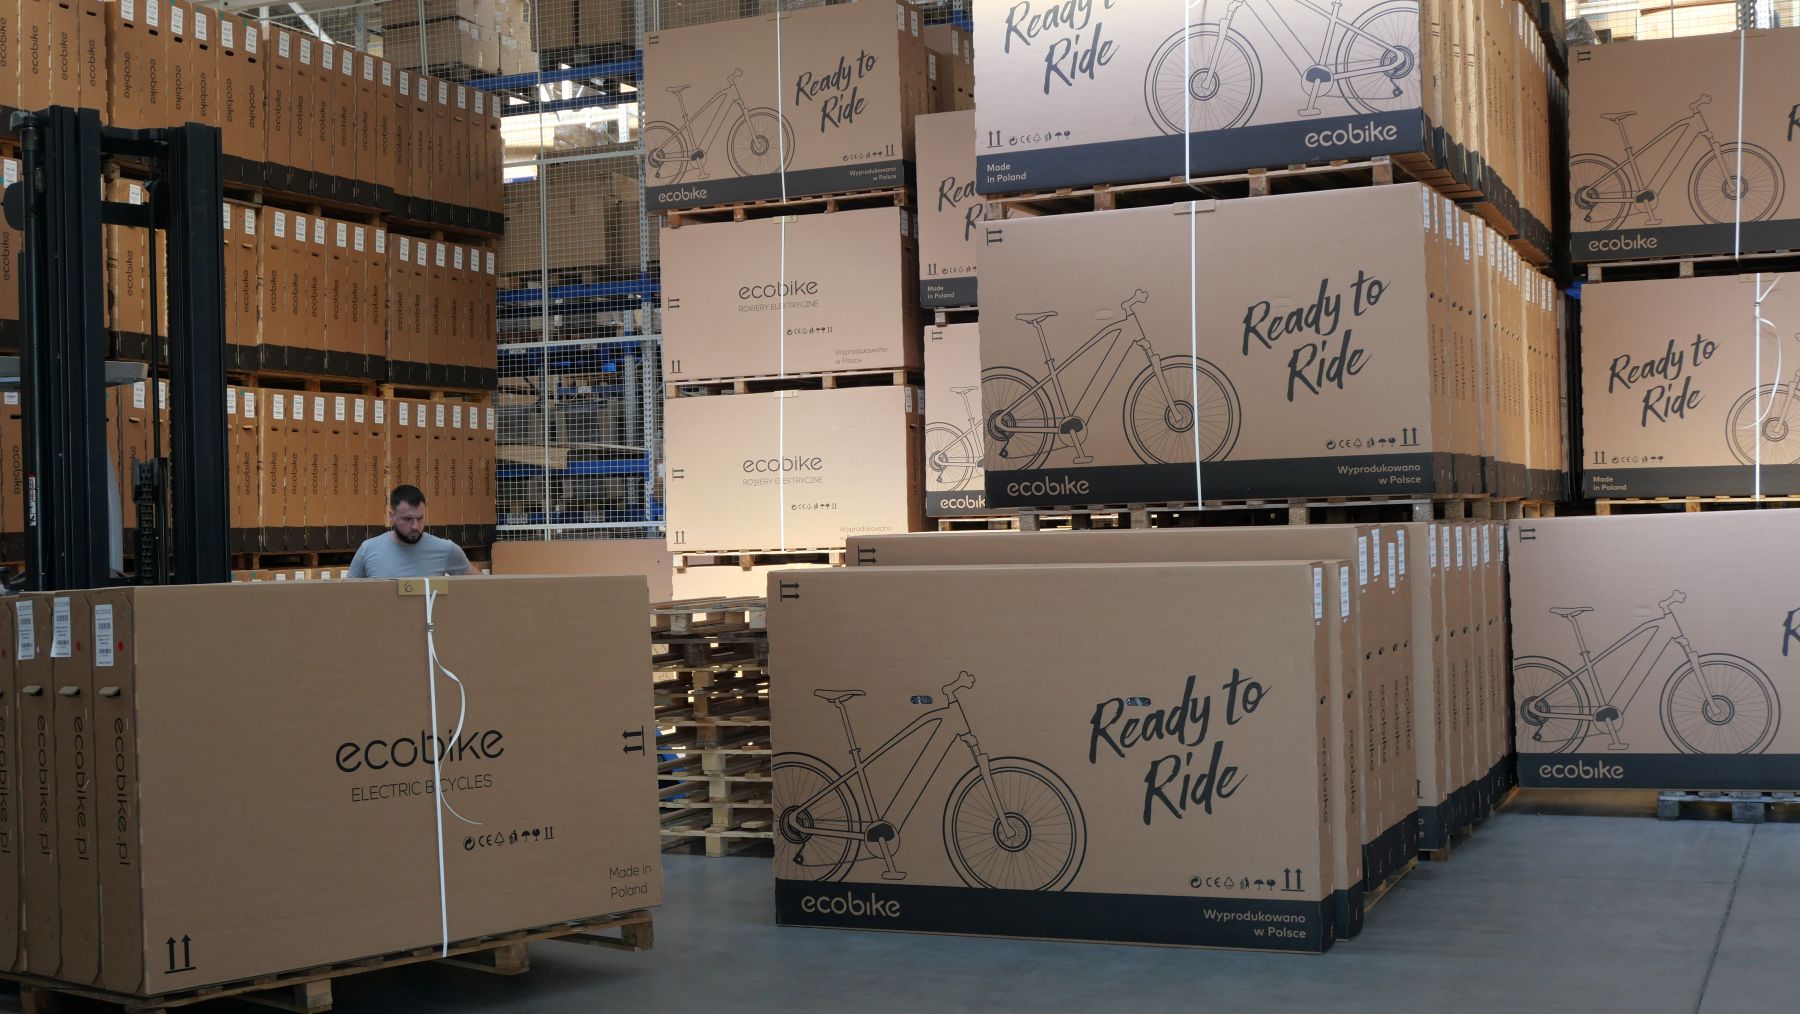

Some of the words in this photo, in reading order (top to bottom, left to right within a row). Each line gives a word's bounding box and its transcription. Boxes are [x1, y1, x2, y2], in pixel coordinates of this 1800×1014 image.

[1004, 0, 1093, 54] Ready
[30, 25, 39, 74] ecobike
[60, 32, 68, 81] ecobike
[87, 39, 96, 87] ecobike
[1044, 22, 1120, 95] Ride
[124, 52, 132, 99] ecobike
[150, 58, 159, 104] ecobike
[175, 65, 184, 111] ecobike
[200, 72, 208, 117] ecobike
[796, 56, 852, 106] Ready
[856, 50, 879, 78] to
[226, 78, 234, 122] ecobike
[249, 85, 257, 128] ecobike
[821, 86, 868, 133] Ride
[1304, 120, 1398, 149] ecobike
[986, 162, 1011, 172] Made
[987, 175, 995, 183] in
[997, 171, 1027, 182] Poland
[658, 187, 708, 203] ecobike
[938, 176, 975, 212] Rea
[2, 231, 10, 281] ecobike
[1588, 235, 1658, 251] ecobike
[126, 249, 134, 297] ecobike
[738, 280, 818, 299] ecobike
[1242, 278, 1341, 356] Ready
[1350, 270, 1391, 316] to
[1287, 329, 1372, 402] Ride
[1608, 339, 1683, 394] Ready
[1691, 334, 1721, 367] to
[1641, 376, 1706, 427] Ride
[12, 445, 22, 496] ecobike
[270, 452, 278, 495] ecobike
[742, 477, 773, 487] ROWERY
[774, 476, 824, 485] EEKTRYCZNE
[743, 456, 823, 473] ecobike
[1337, 463, 1421, 475] Wyprodukowano
[1379, 477, 1387, 485] w
[1390, 475, 1421, 484] Polsce
[940, 495, 985, 509] ecobik
[1006, 476, 1090, 497] ecobike
[405, 581, 413, 592] 6
[1089, 675, 1211, 764] Ready
[1222, 668, 1272, 725] to
[336, 729, 504, 772] ecobike
[1539, 760, 1624, 779] ecobike
[37, 715, 50, 855] ecobike.pl
[74, 716, 89, 860] ecobike.pl
[114, 717, 131, 865] ecobike.pl
[351, 780, 421, 802] ELECTRIC
[425, 773, 493, 794] BCYCLES
[1143, 741, 1248, 826] Ride
[609, 866, 640, 880] Made
[642, 864, 652, 873] in
[610, 882, 648, 898] Poland
[800, 891, 901, 918] ecobike
[1203, 909, 1306, 924] Wyprodukowano
[1254, 927, 1264, 936] w
[1268, 926, 1307, 938] Polsce
